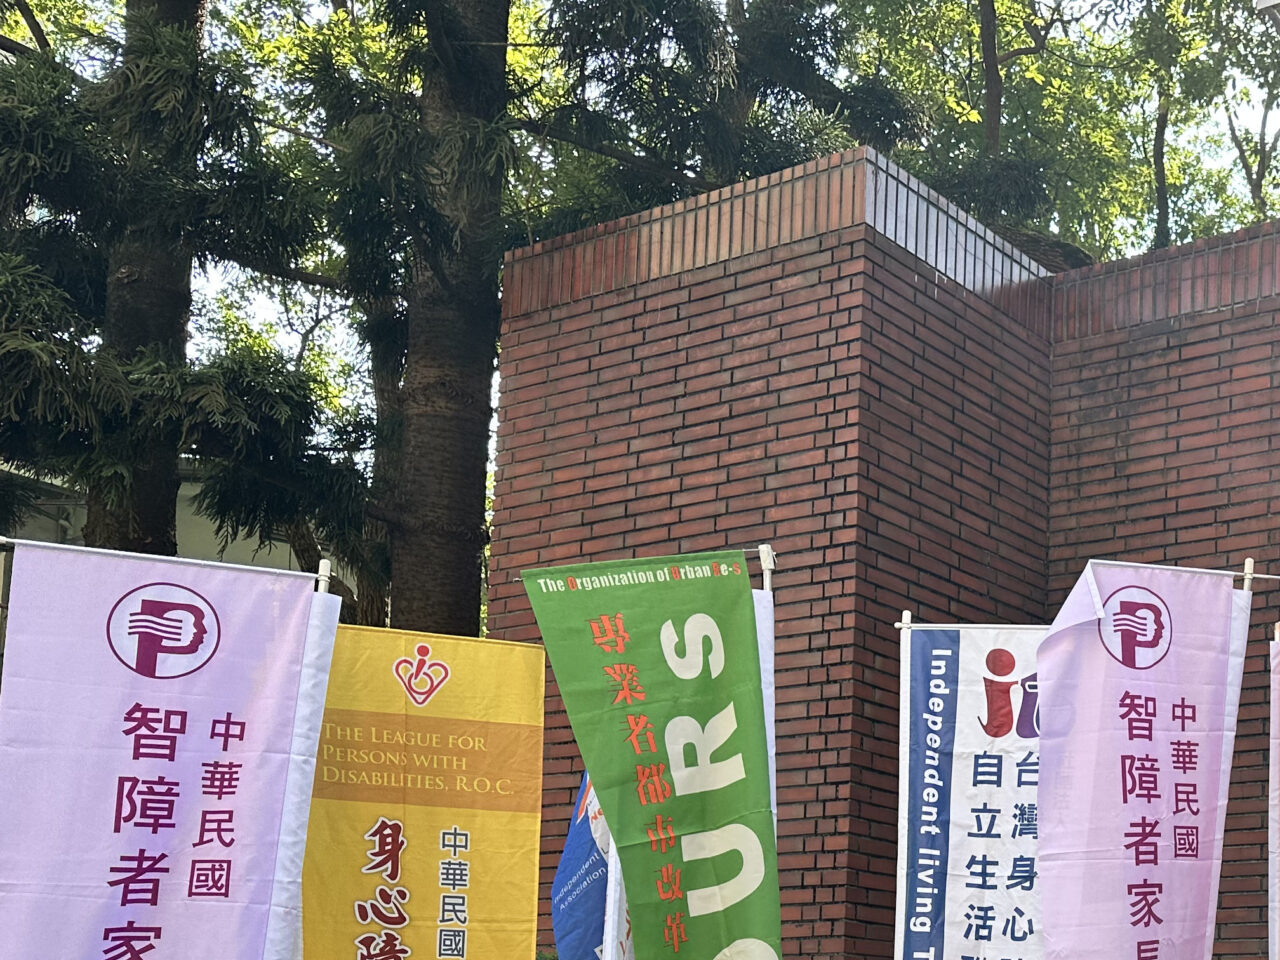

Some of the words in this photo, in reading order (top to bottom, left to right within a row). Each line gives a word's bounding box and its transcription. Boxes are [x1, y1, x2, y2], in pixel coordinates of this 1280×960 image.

[537, 577, 566, 593] The
[566, 569, 655, 592] Organization
[657, 567, 671, 583] of
[671, 563, 712, 582] Urban
[712, 561, 742, 578] Re-s
[322, 744, 408, 767] PERSONS
[413, 752, 468, 771] WITH
[323, 723, 364, 742] THE
[371, 726, 442, 748] LEAGUE
[448, 735, 488, 752] FOR
[919, 648, 953, 837] Independent
[1169, 697, 1201, 861] 中華民國
[187, 711, 247, 899] 中華民國
[437, 826, 470, 960] 中華民國
[910, 847, 942, 933] living
